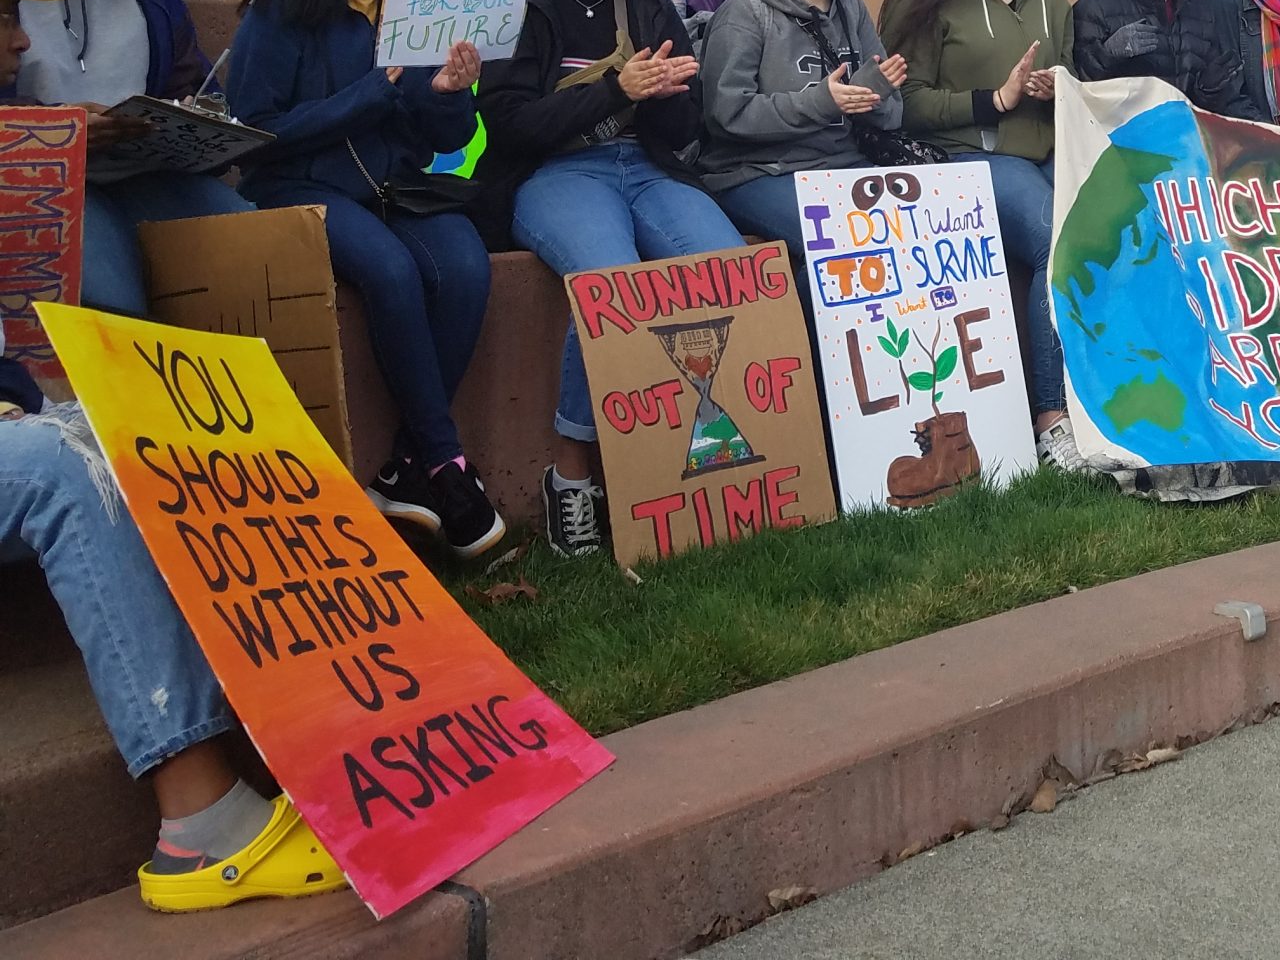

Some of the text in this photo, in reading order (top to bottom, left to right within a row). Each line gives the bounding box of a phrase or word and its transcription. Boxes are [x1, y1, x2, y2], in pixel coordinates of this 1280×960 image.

[382, 12, 521, 60] FUTURE
[804, 205, 835, 251] I
[847, 203, 921, 247] DON'T
[827, 235, 1006, 297] TO SURVIVE
[569, 246, 788, 339] RUNNING
[866, 303, 884, 323] I
[934, 289, 956, 306] TO
[133, 339, 254, 435] YOU
[602, 357, 802, 434] OUT OF
[134, 436, 321, 516] SHOULD
[631, 465, 806, 560] TIME
[176, 514, 378, 594] DO THIS
[213, 570, 425, 670] WITHOUT
[331, 642, 421, 713] US
[343, 694, 548, 829] ASKING
